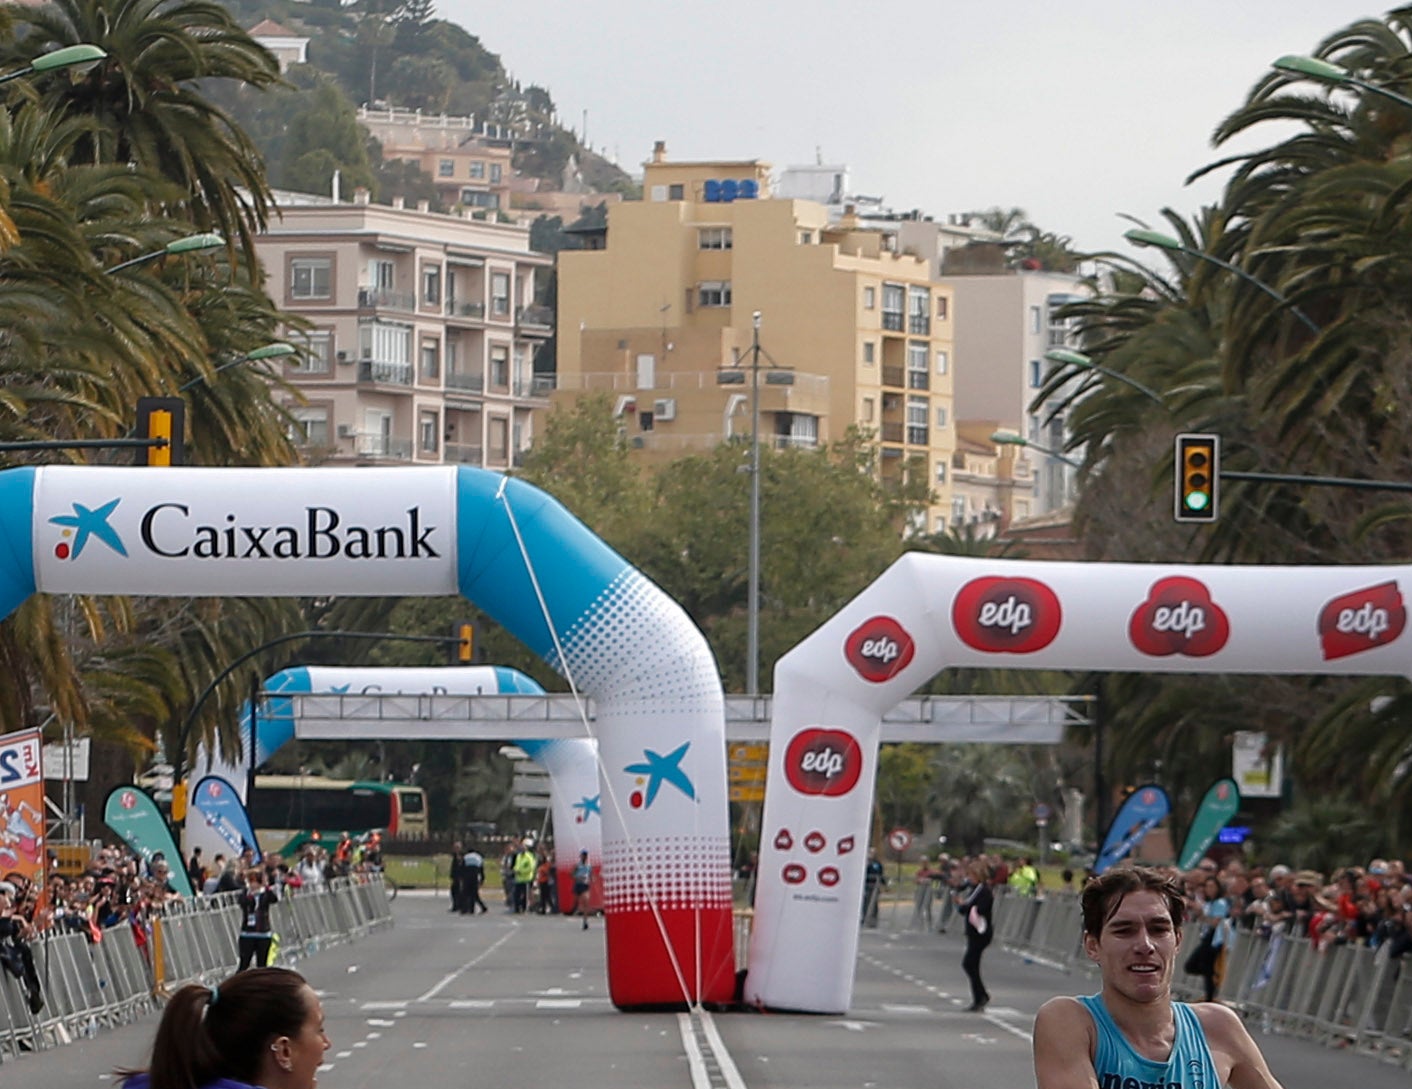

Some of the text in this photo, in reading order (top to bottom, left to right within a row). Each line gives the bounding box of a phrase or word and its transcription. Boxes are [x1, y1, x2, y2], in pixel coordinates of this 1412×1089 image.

[140, 502, 441, 560] CaixaBank
[978, 596, 1031, 634] edp
[1152, 601, 1205, 638] edp
[1336, 602, 1388, 638] edp
[861, 636, 897, 662] edp
[801, 748, 843, 778] edp
